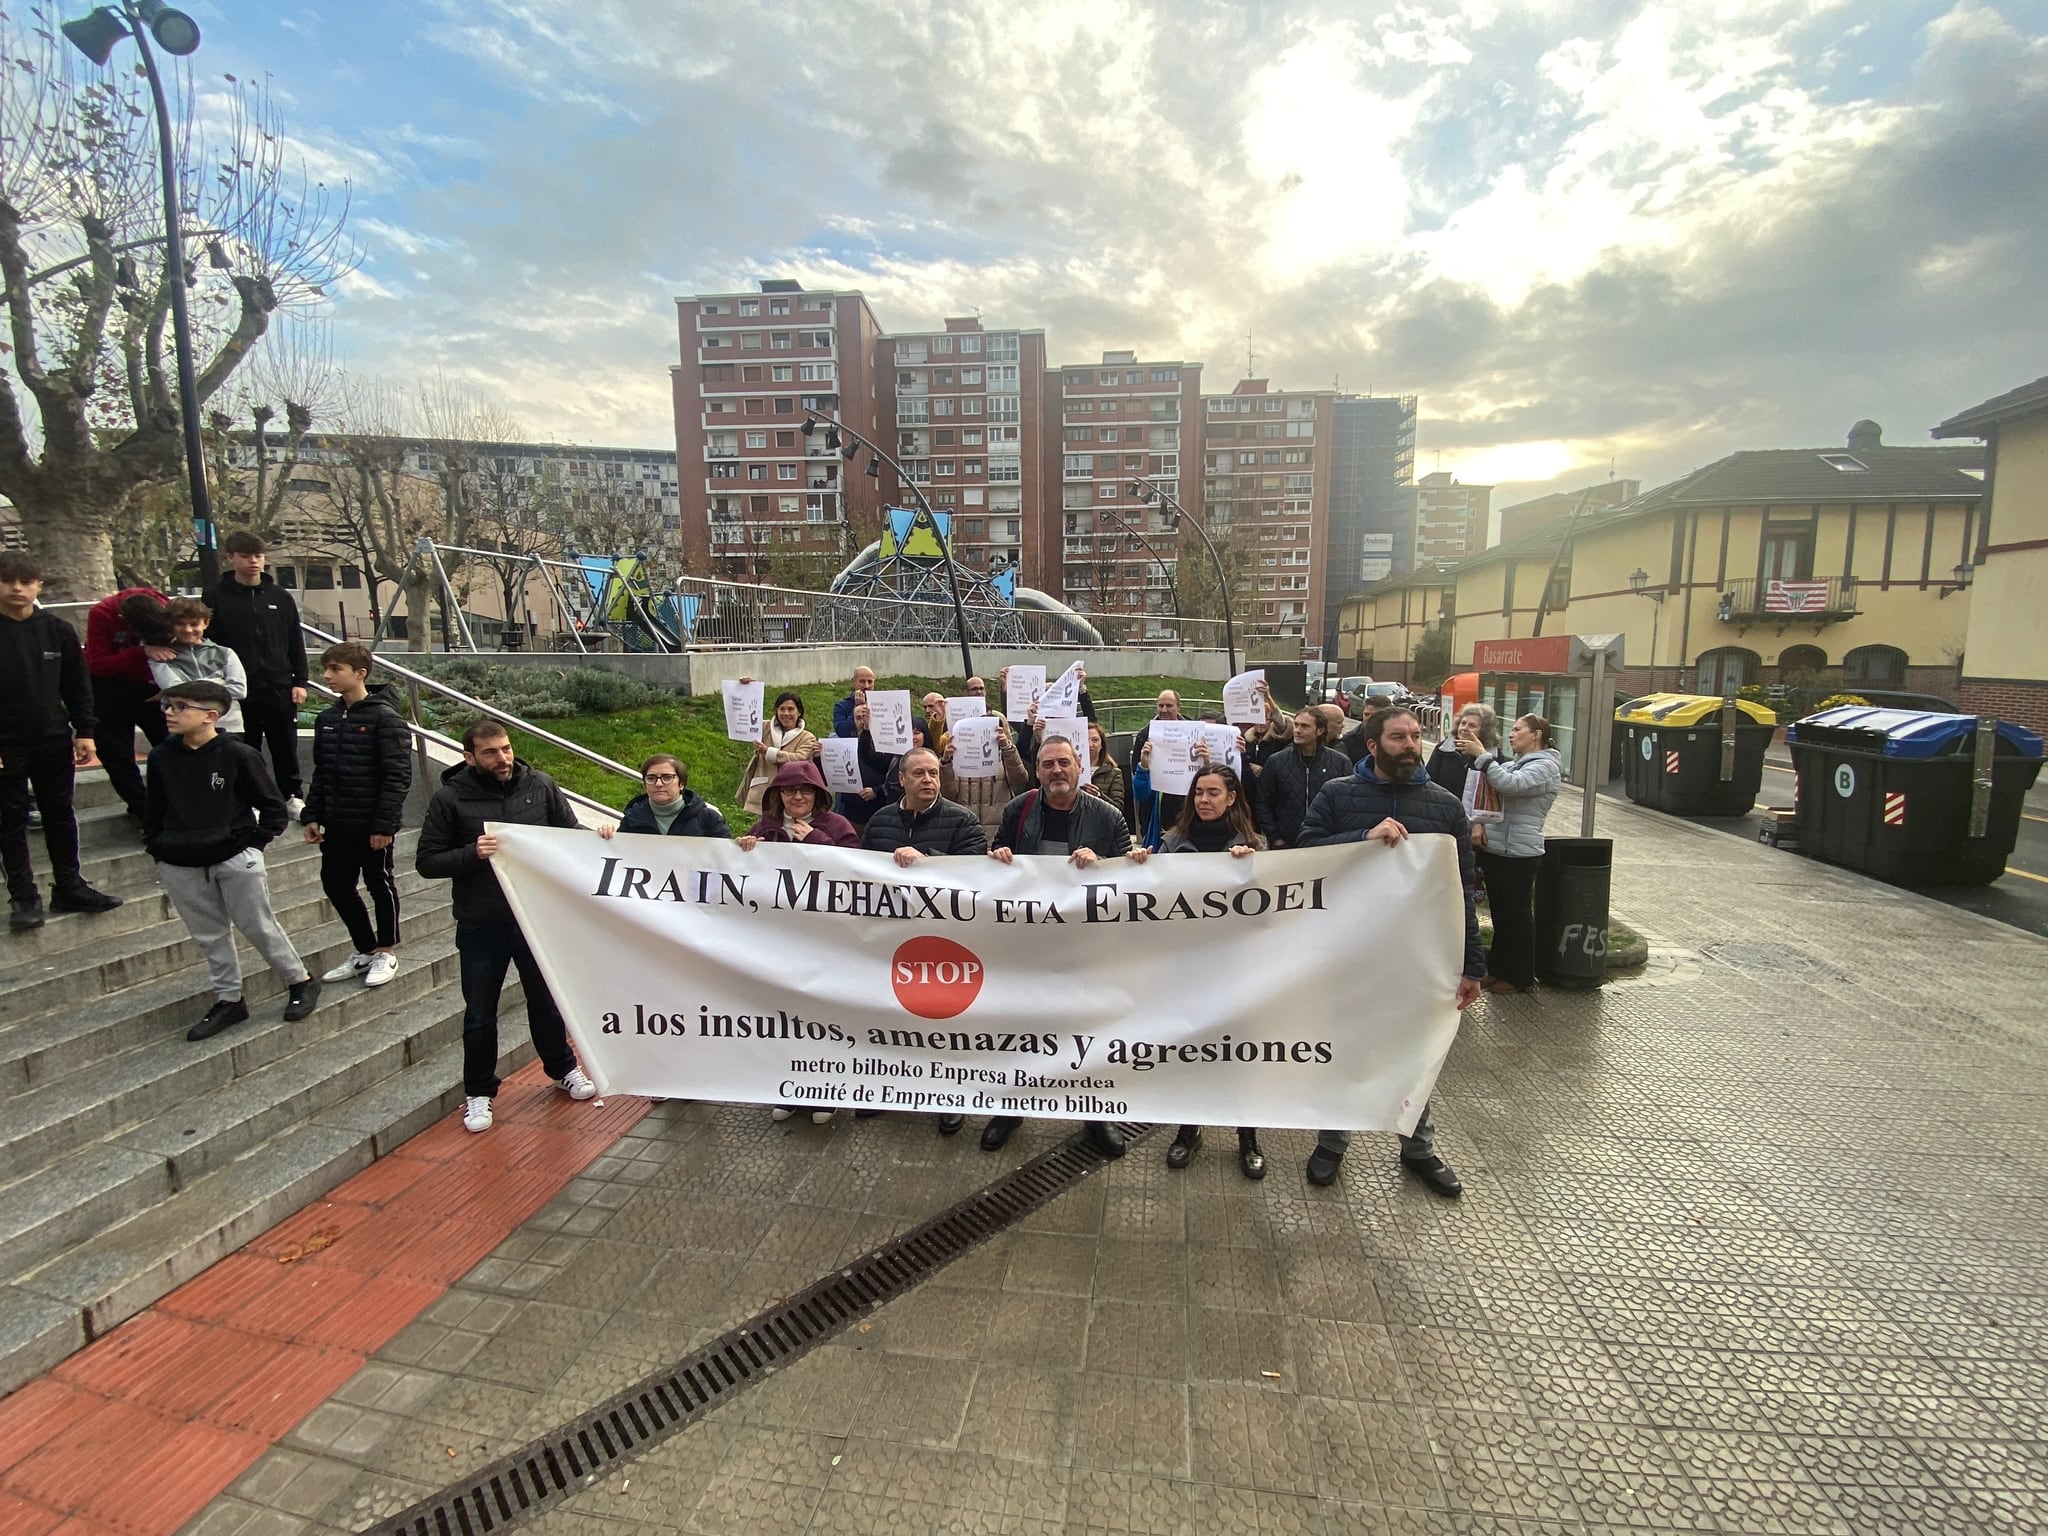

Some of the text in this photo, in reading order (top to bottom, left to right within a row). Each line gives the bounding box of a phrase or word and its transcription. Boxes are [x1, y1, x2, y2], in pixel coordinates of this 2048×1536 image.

[1483, 646, 1523, 665] Basarrate
[1839, 771, 1851, 790] B
[993, 898, 1066, 924] ETA
[1081, 876, 1329, 924] ERASOEI
[896, 961, 980, 985] STOP
[602, 1005, 1334, 1072] a los insultos, amenazas y agresiones
[790, 1058, 1116, 1089] metro bilboko Enpresa Batzordea
[778, 1080, 1128, 1115] Comité de Empresa de metro bilbao
